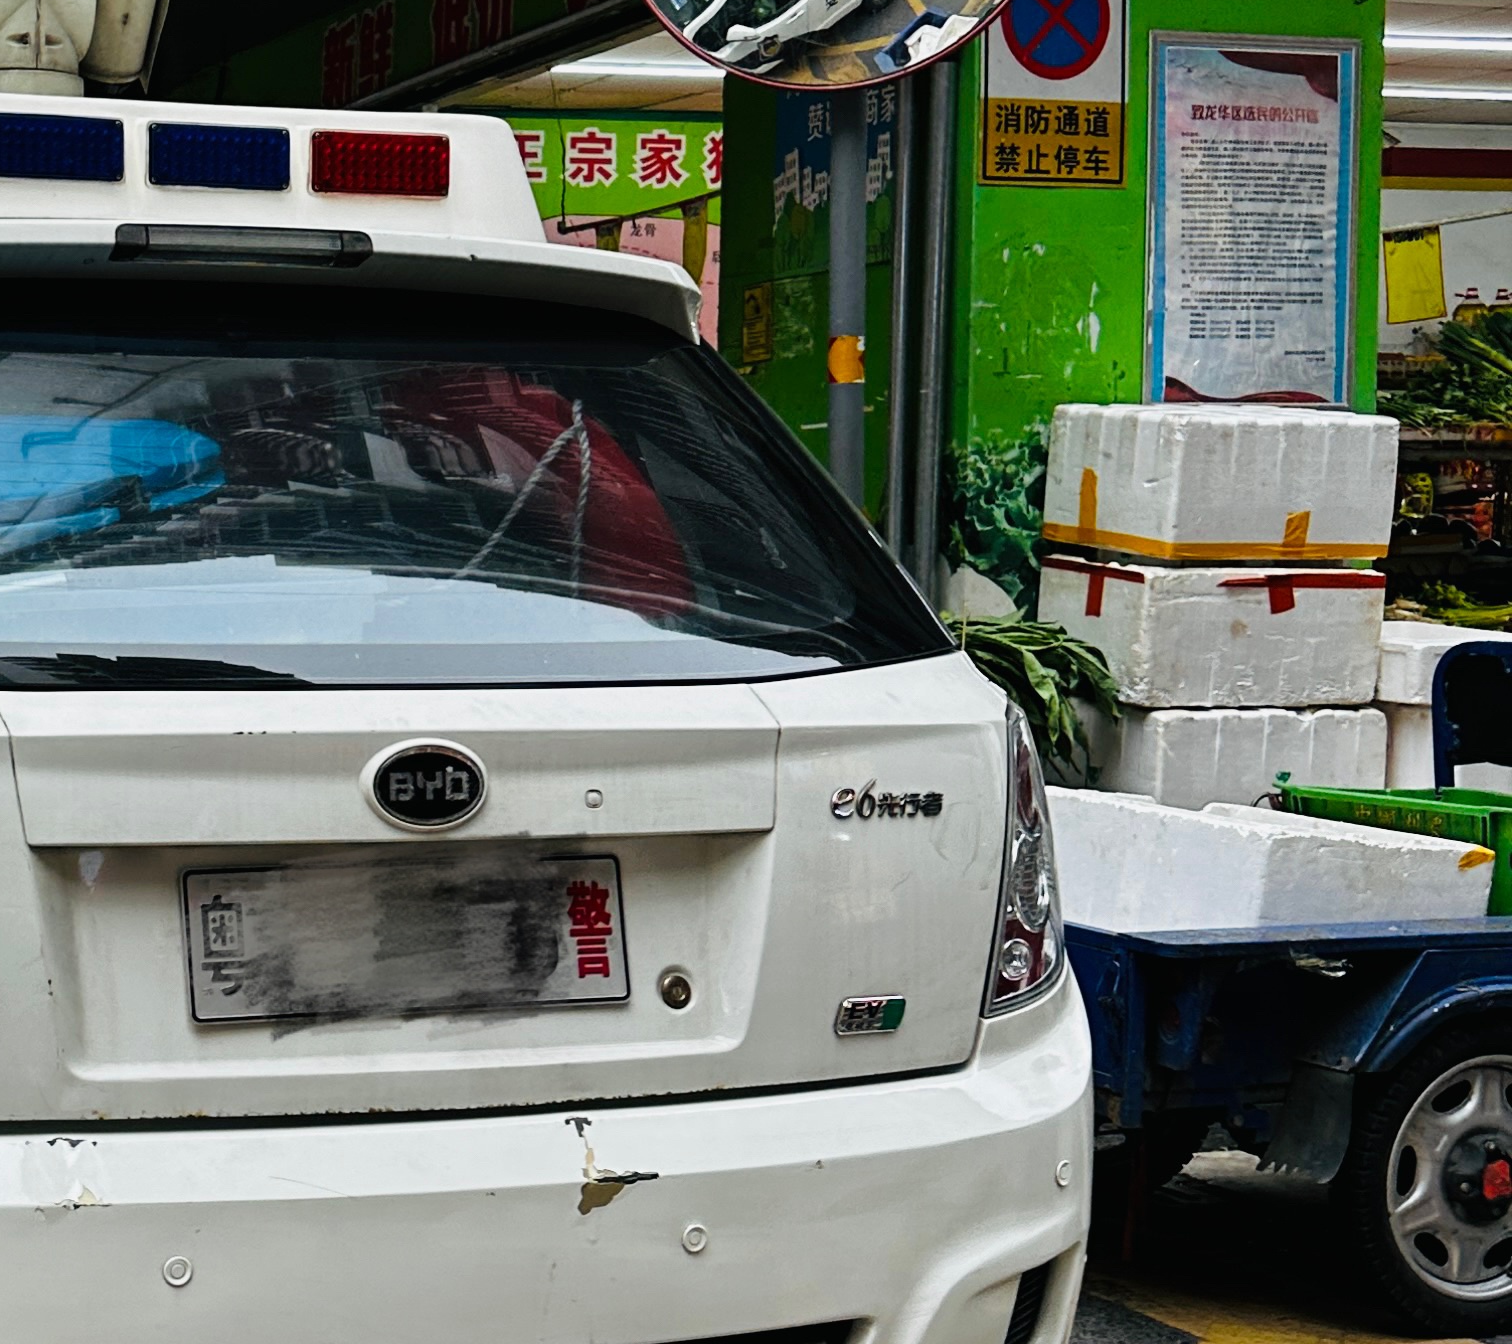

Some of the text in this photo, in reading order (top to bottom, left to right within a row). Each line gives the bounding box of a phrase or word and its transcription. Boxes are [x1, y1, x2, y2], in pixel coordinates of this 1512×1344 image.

[995, 103, 1110, 137] 消防通道
[994, 142, 1110, 176] 禁止停车
[389, 769, 470, 801] BYD
[566, 871, 613, 979] 警
